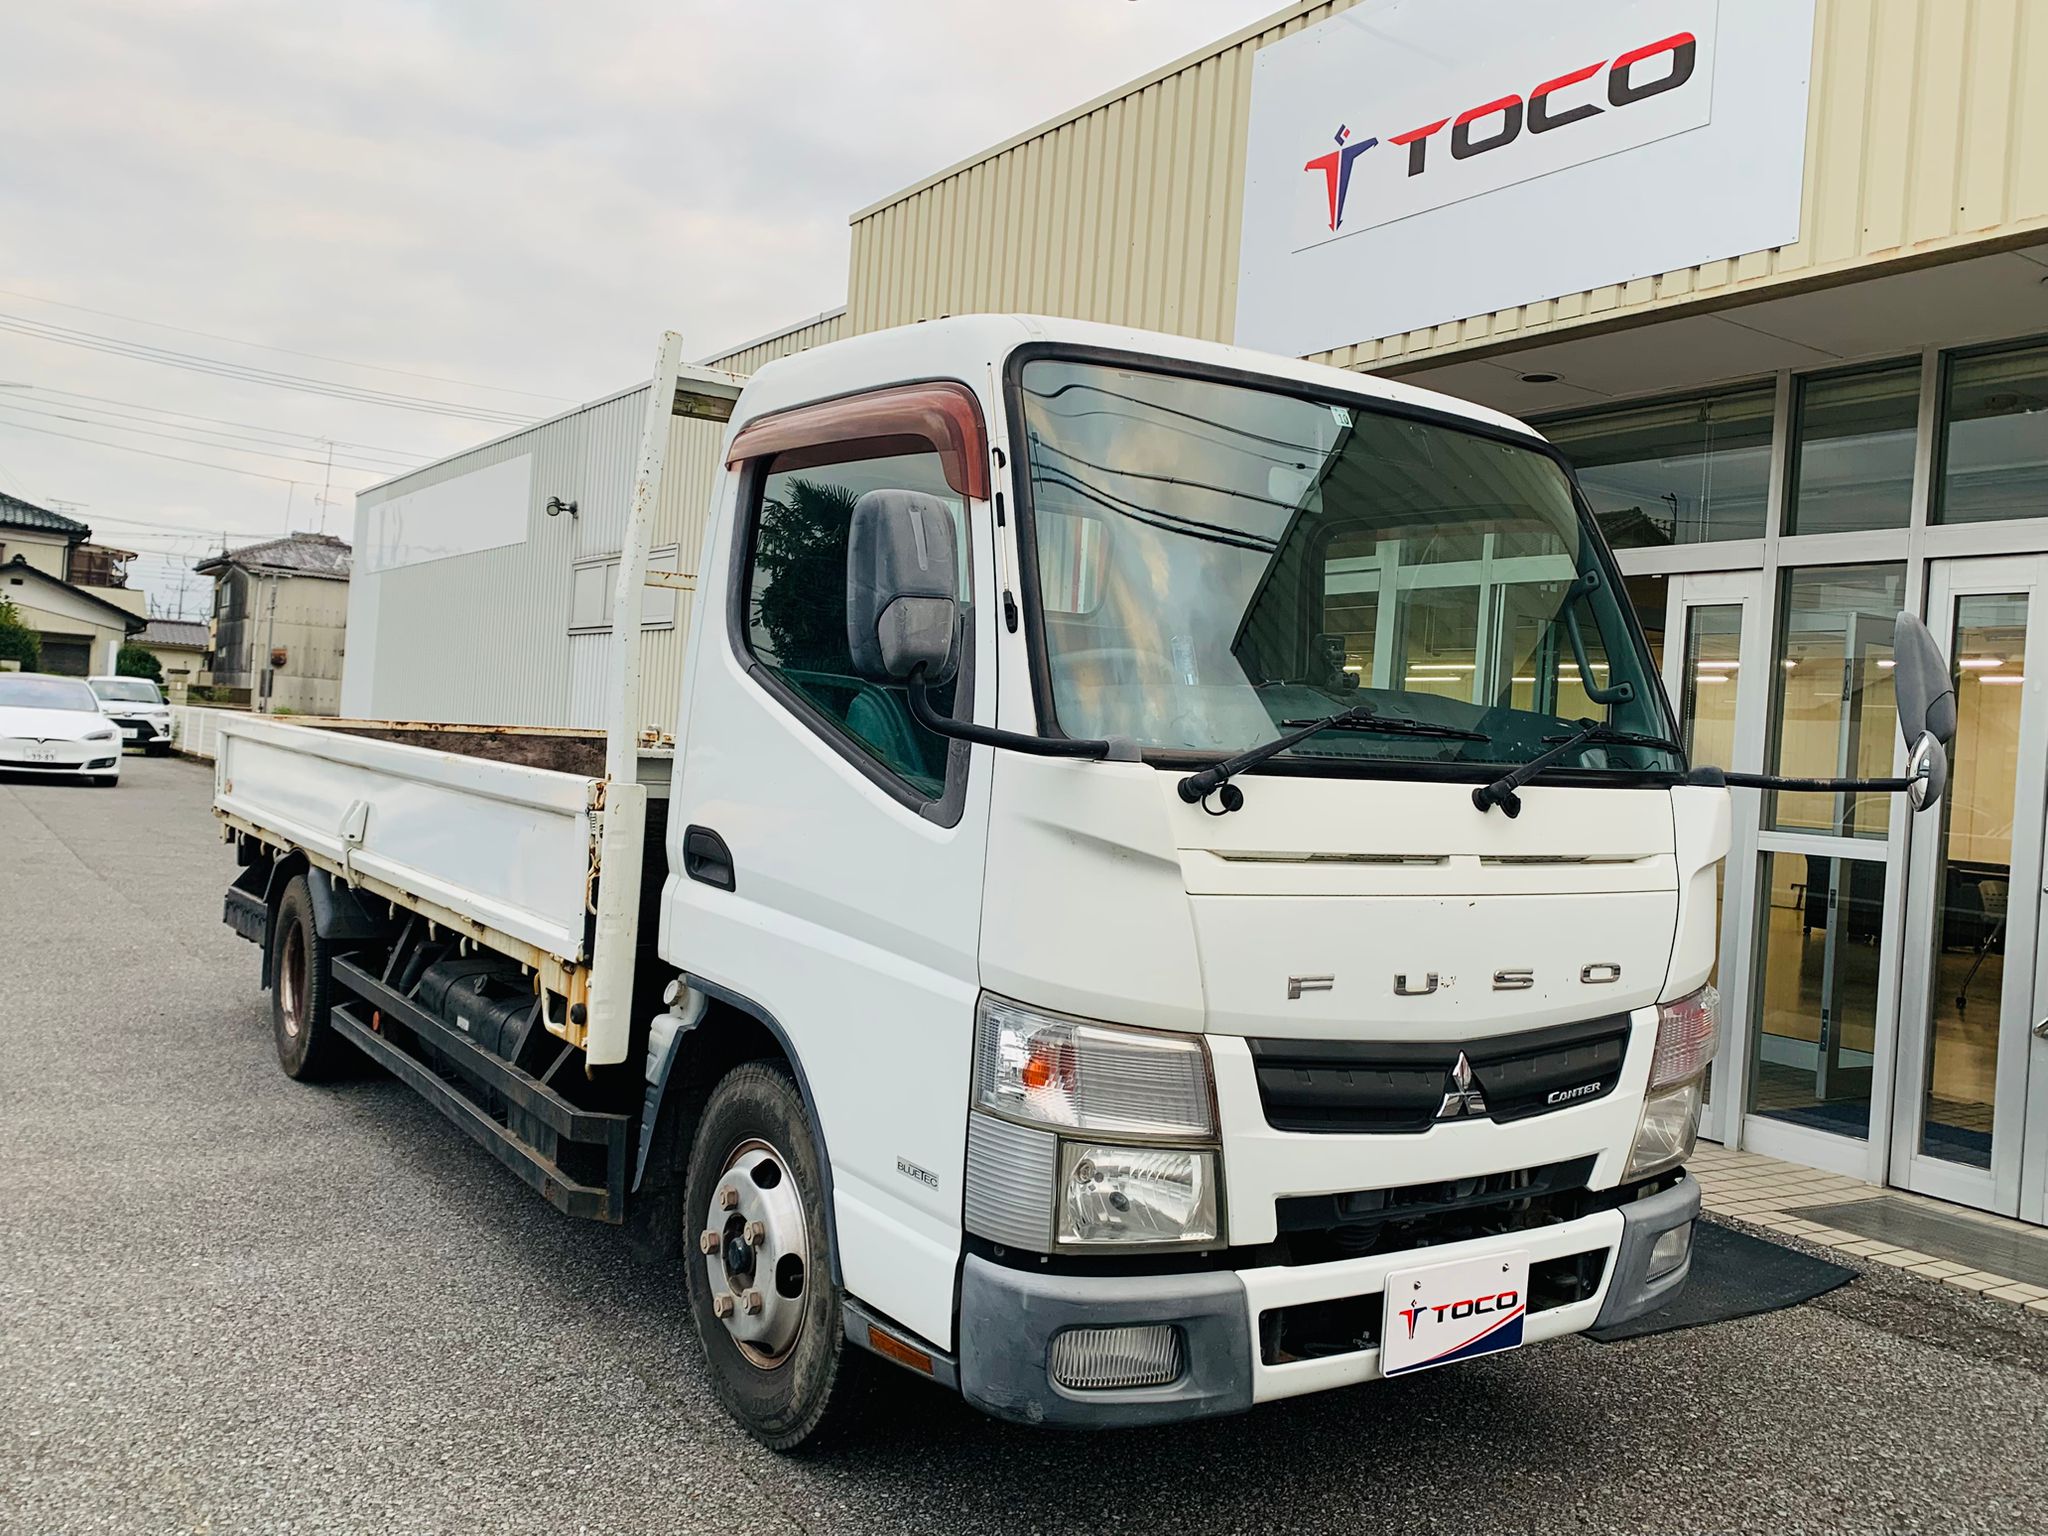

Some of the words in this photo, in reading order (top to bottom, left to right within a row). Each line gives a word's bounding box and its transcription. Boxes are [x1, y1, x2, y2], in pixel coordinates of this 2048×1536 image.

[1387, 31, 1696, 177] TOCO
[1287, 962, 1621, 1000] FUSO
[1547, 1081, 1601, 1104] CANTER
[1430, 1290, 1518, 1323] TOCO
